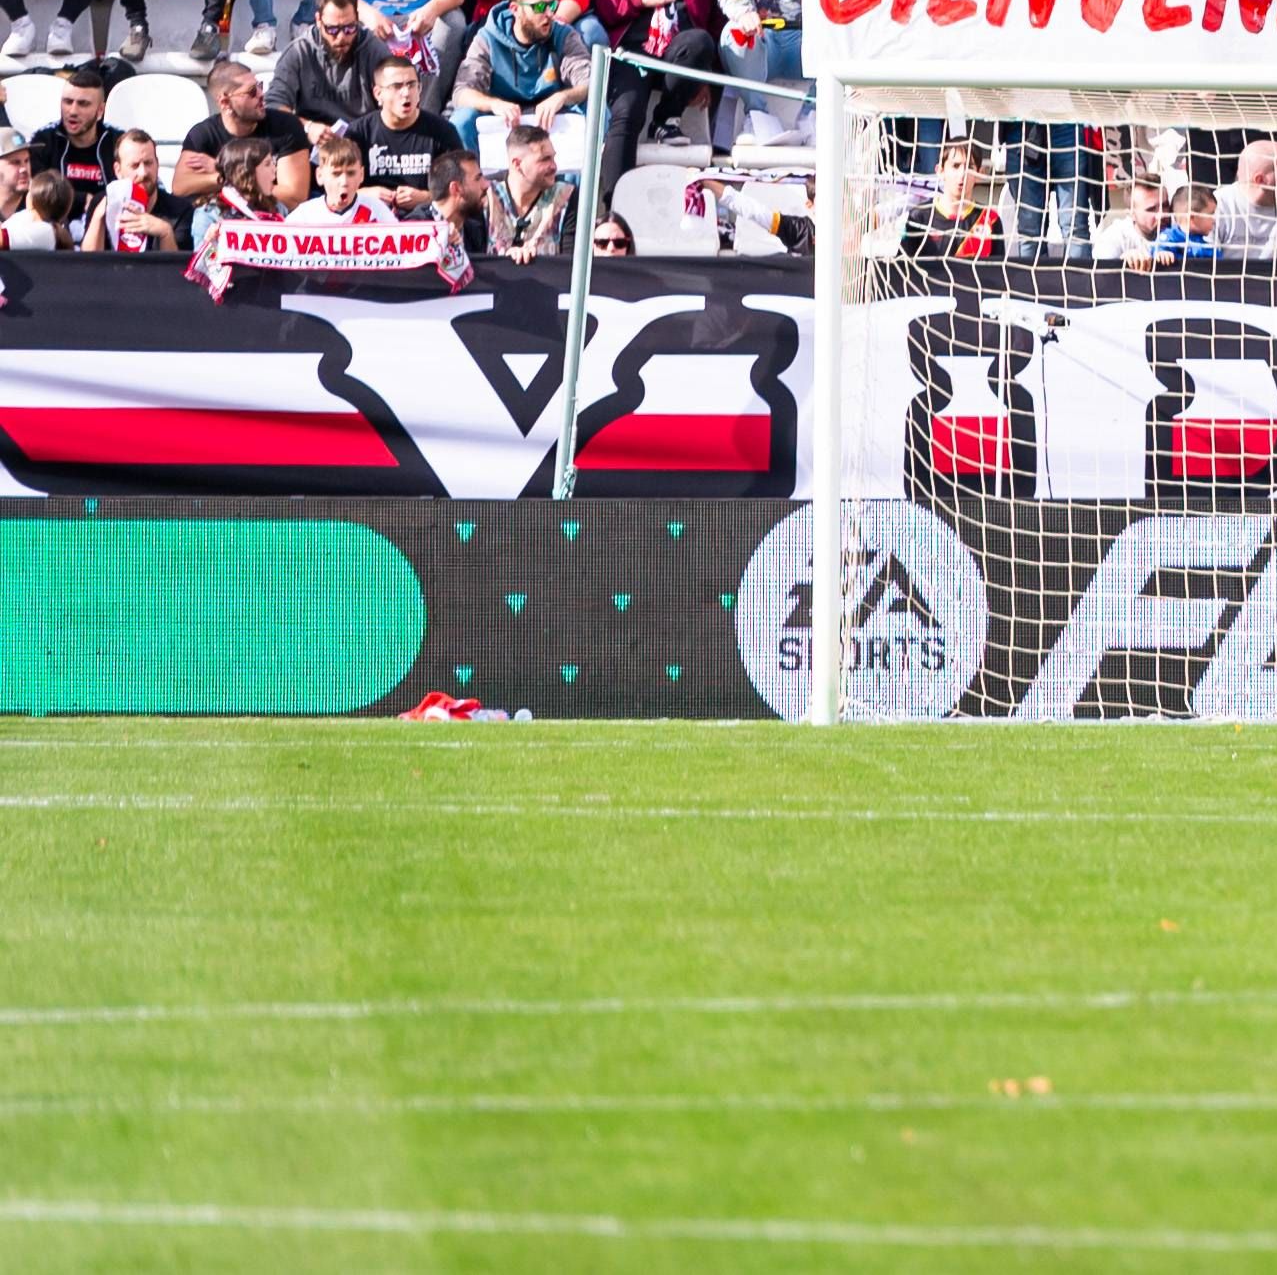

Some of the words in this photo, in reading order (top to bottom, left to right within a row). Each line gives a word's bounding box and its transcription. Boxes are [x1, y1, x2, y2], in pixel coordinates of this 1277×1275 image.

[377, 153, 432, 168] SOLDIER
[225, 231, 288, 253] RAYO
[294, 233, 432, 257] VALLECANO
